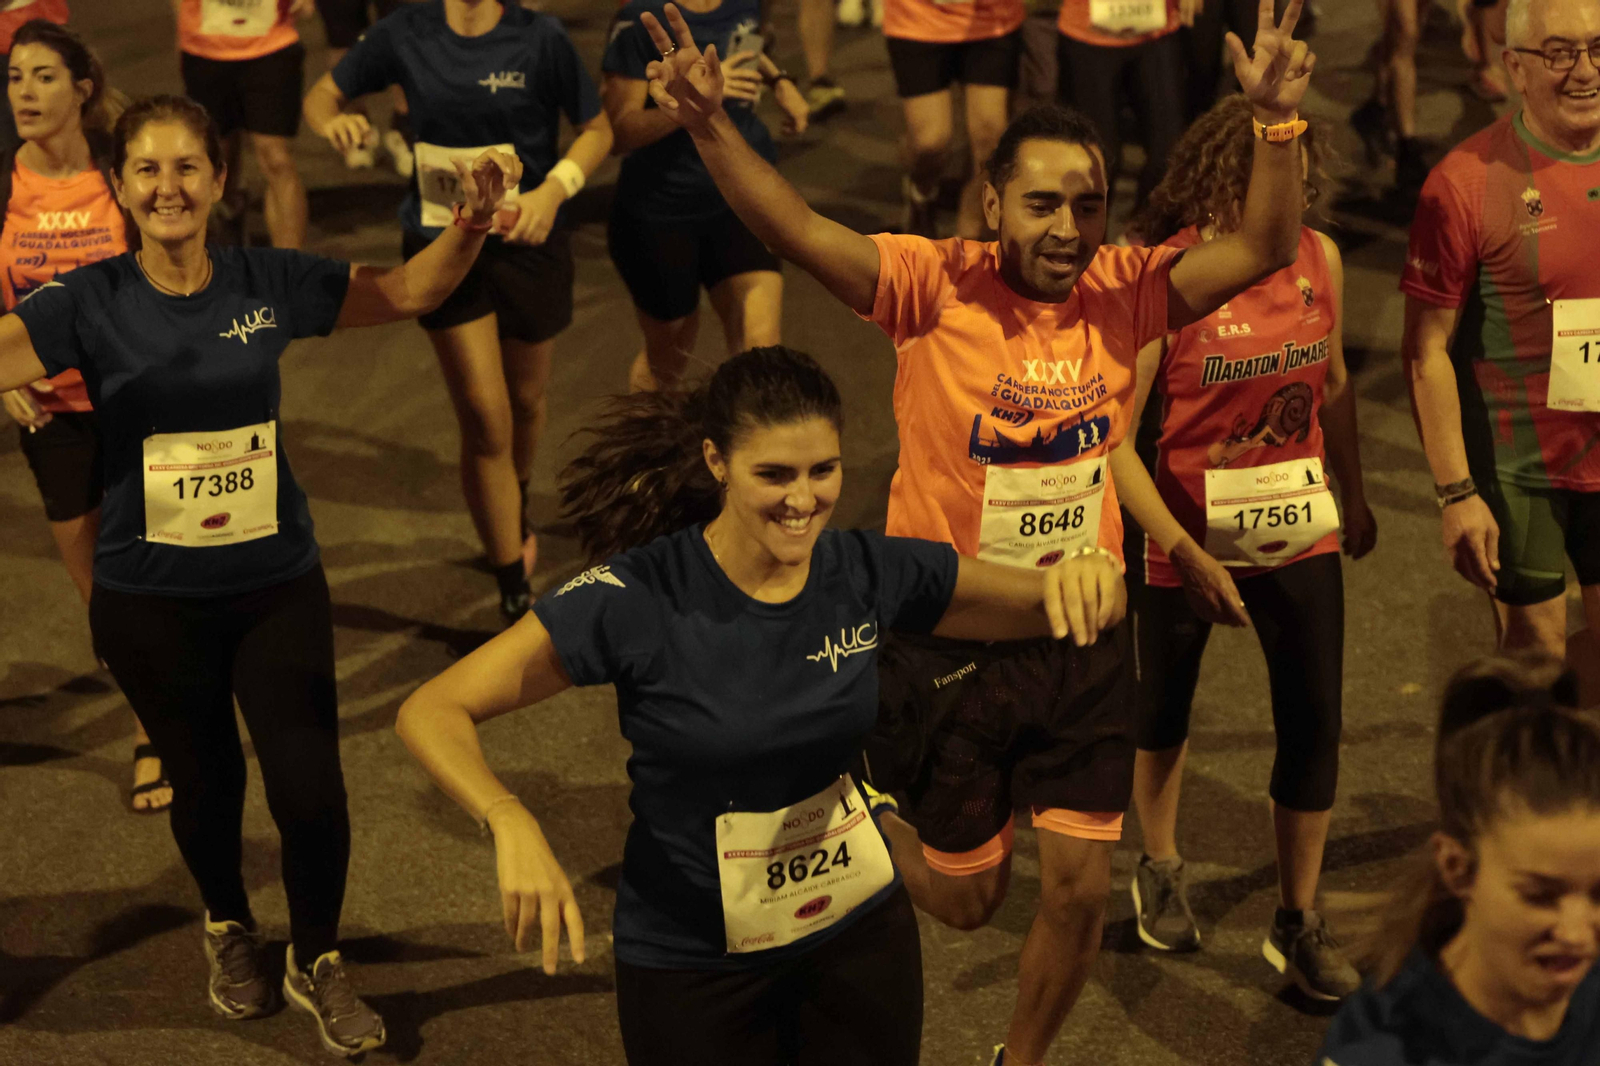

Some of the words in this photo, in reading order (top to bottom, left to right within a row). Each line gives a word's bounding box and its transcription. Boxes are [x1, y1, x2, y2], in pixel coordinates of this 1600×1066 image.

[37, 211, 91, 230] XXXV
[19, 234, 112, 250] GUADALQUIVIR
[1201, 351, 1281, 387] MARATON
[1282, 336, 1329, 376] TOMARE
[991, 383, 1001, 397] DEL
[1000, 384, 1107, 410] GUADALQUIVIR
[997, 373, 1047, 395] CARRERA
[1048, 372, 1104, 397] NOCTURNA
[173, 467, 254, 499] 17388
[1019, 505, 1084, 536] 8648
[1233, 501, 1312, 530] 17561
[933, 661, 977, 689] Fansport
[766, 840, 851, 890] 8624
[789, 885, 819, 899] ALCAIDE
[820, 870, 862, 889] CARRASCO
